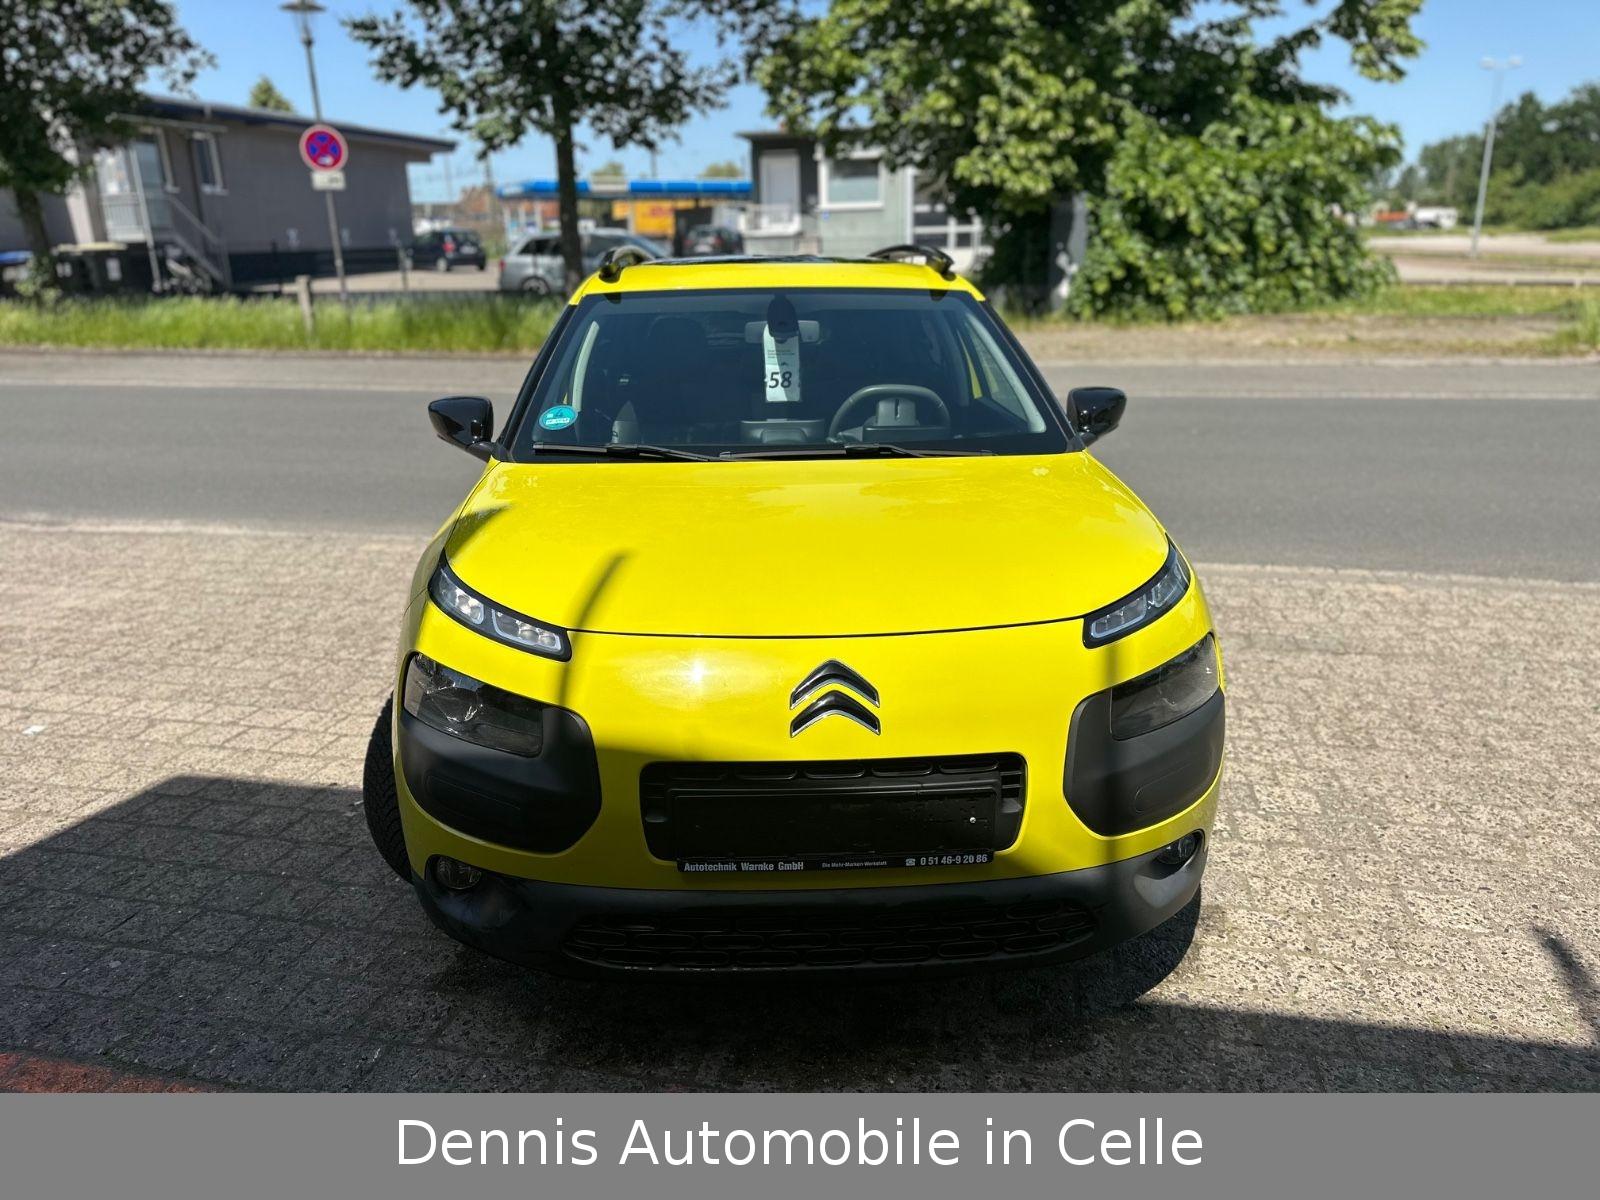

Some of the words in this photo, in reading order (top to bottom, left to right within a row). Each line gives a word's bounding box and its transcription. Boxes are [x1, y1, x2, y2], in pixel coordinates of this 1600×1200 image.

[769, 371, 792, 389] 58
[920, 857, 926, 866] 0
[928, 856, 939, 865] 51
[941, 856, 961, 865] 46-9
[963, 855, 974, 864] 20
[976, 854, 988, 863] 86
[684, 862, 737, 872] Autotechnik
[741, 862, 774, 871] Warnke
[778, 861, 804, 871] GmbH
